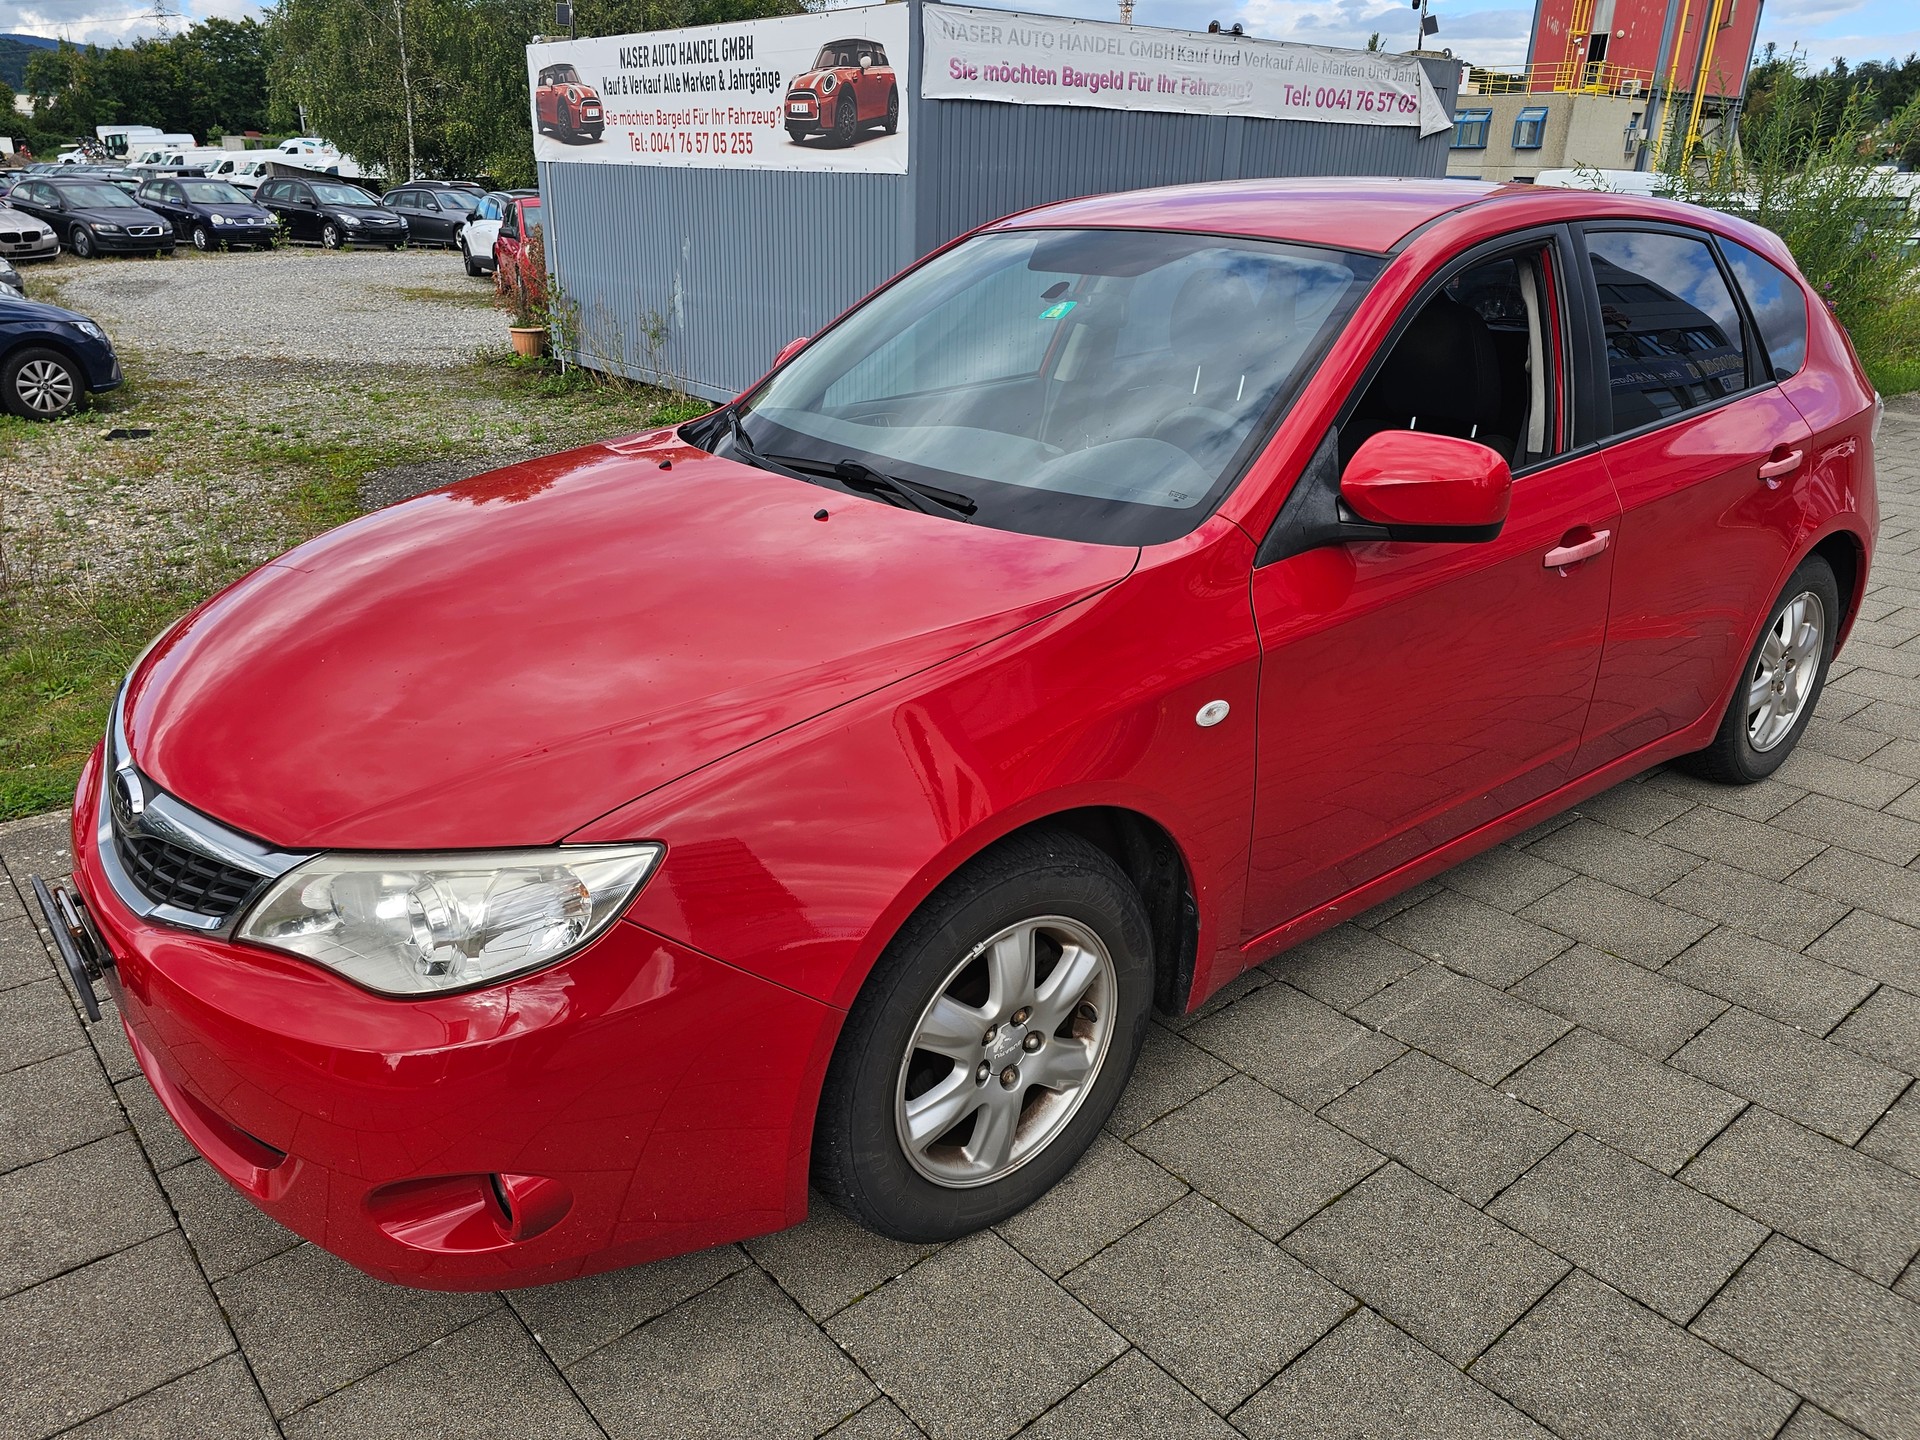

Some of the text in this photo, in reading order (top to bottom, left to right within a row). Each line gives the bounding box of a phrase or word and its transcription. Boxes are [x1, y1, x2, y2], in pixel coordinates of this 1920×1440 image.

[620, 35, 754, 69] NASER AUTO HANDEL GMBH
[942, 21, 1003, 45] NASER
[1007, 27, 1055, 49] AUTO
[1059, 33, 1125, 56] HANDEL
[1129, 39, 1174, 60] GMBH
[1177, 45, 1209, 63] Kauf
[1213, 49, 1240, 66] Und
[1244, 51, 1294, 71] Verkauf
[1296, 58, 1319, 73] Alle
[1322, 60, 1365, 78] Marken
[1368, 65, 1390, 80] Und
[602, 67, 781, 95] Kauf & Verkauf Alle Marken & Jahrgänge
[949, 57, 978, 80] Sie
[983, 60, 1057, 86] möchten
[1062, 65, 1124, 94] Bargeld
[1127, 71, 1154, 92] Für
[1157, 73, 1178, 94] Ihr
[1284, 84, 1417, 113] Tel: 0041 76 57 05
[605, 106, 782, 129] Sie möchten Bargeld Für Ihr Fahrzeug?
[628, 132, 753, 154] Tel: 0041 76 57 05 255
